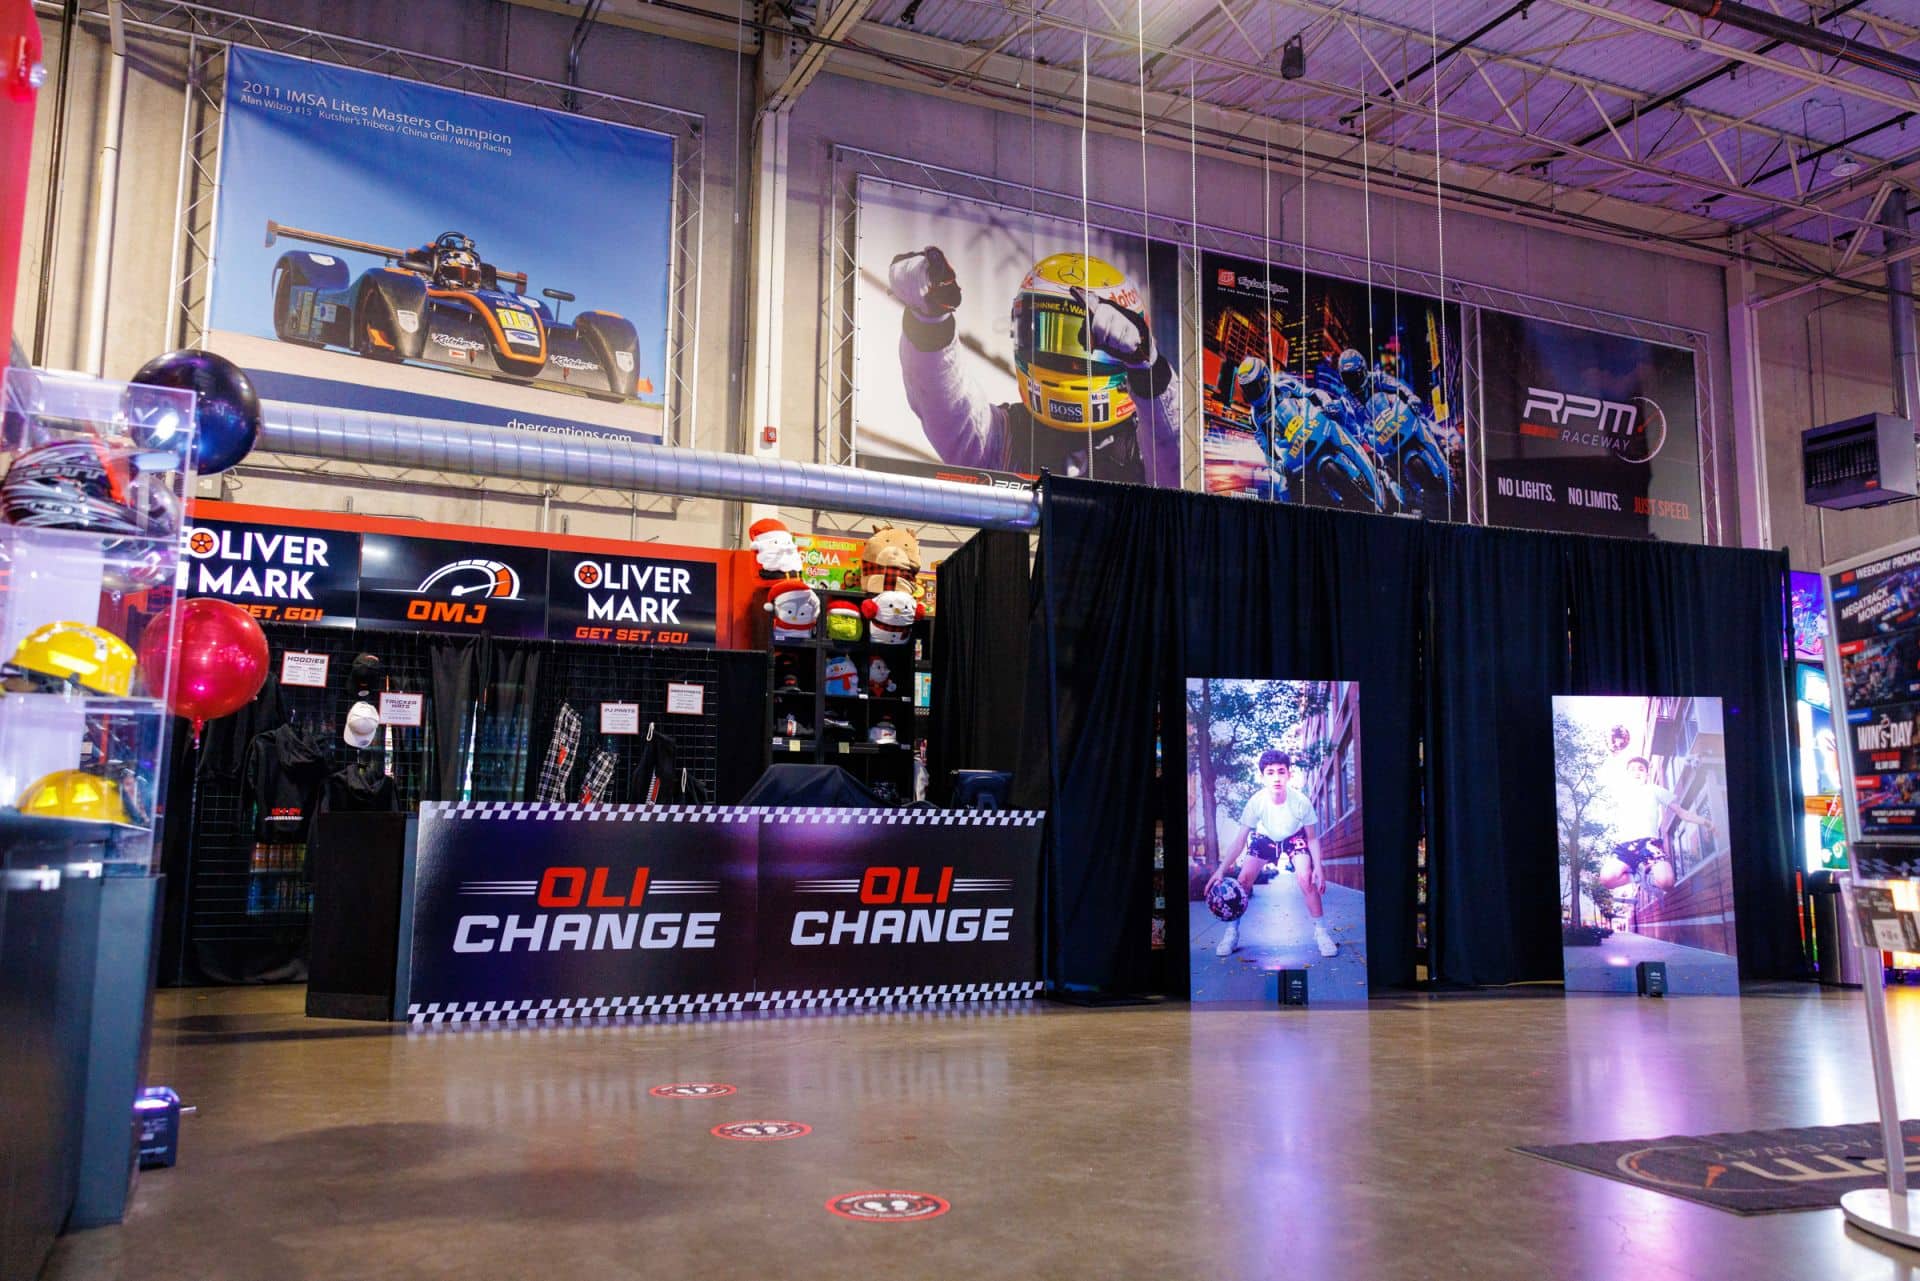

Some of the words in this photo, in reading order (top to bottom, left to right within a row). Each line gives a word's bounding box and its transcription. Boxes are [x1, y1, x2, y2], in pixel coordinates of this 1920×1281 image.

[240, 94, 262, 106] Alan
[263, 99, 293, 113] Wilzig
[362, 118, 395, 133] Tribeca
[402, 126, 428, 139] China
[429, 130, 448, 143] Grill
[455, 136, 481, 152] Wilzig
[483, 143, 512, 157] Racing
[242, 80, 280, 98] 2011
[286, 90, 328, 108] IMSA
[332, 98, 368, 116] Lites
[371, 106, 432, 129] Masters
[435, 119, 512, 145] Champion
[1050, 401, 1083, 417] BOSS
[1522, 387, 1638, 436] RPM
[1561, 430, 1631, 450] RACEWAY
[1498, 476, 1513, 496] NO
[1516, 480, 1556, 502] LIGHTS.
[1568, 486, 1584, 506] NO
[1586, 491, 1622, 511] LIMITS.
[1634, 495, 1657, 515] JUST
[1658, 500, 1691, 521] SPEED.
[190, 527, 329, 567] OLIVER
[198, 563, 315, 600] MARK
[574, 560, 692, 595] OLIVER
[1856, 559, 1892, 580] WEEKDAY
[284, 607, 323, 621] GO!
[407, 600, 487, 624] OMJ
[587, 592, 680, 625] MARK
[1841, 585, 1889, 619] MEGATRACK
[1857, 594, 1897, 623] MONDAYS
[576, 626, 612, 640] GET
[657, 631, 689, 644] GO!
[537, 867, 649, 907] OLI
[860, 867, 954, 904] OLI
[452, 913, 721, 953] CHANGE
[790, 908, 1014, 946] CHANGE
